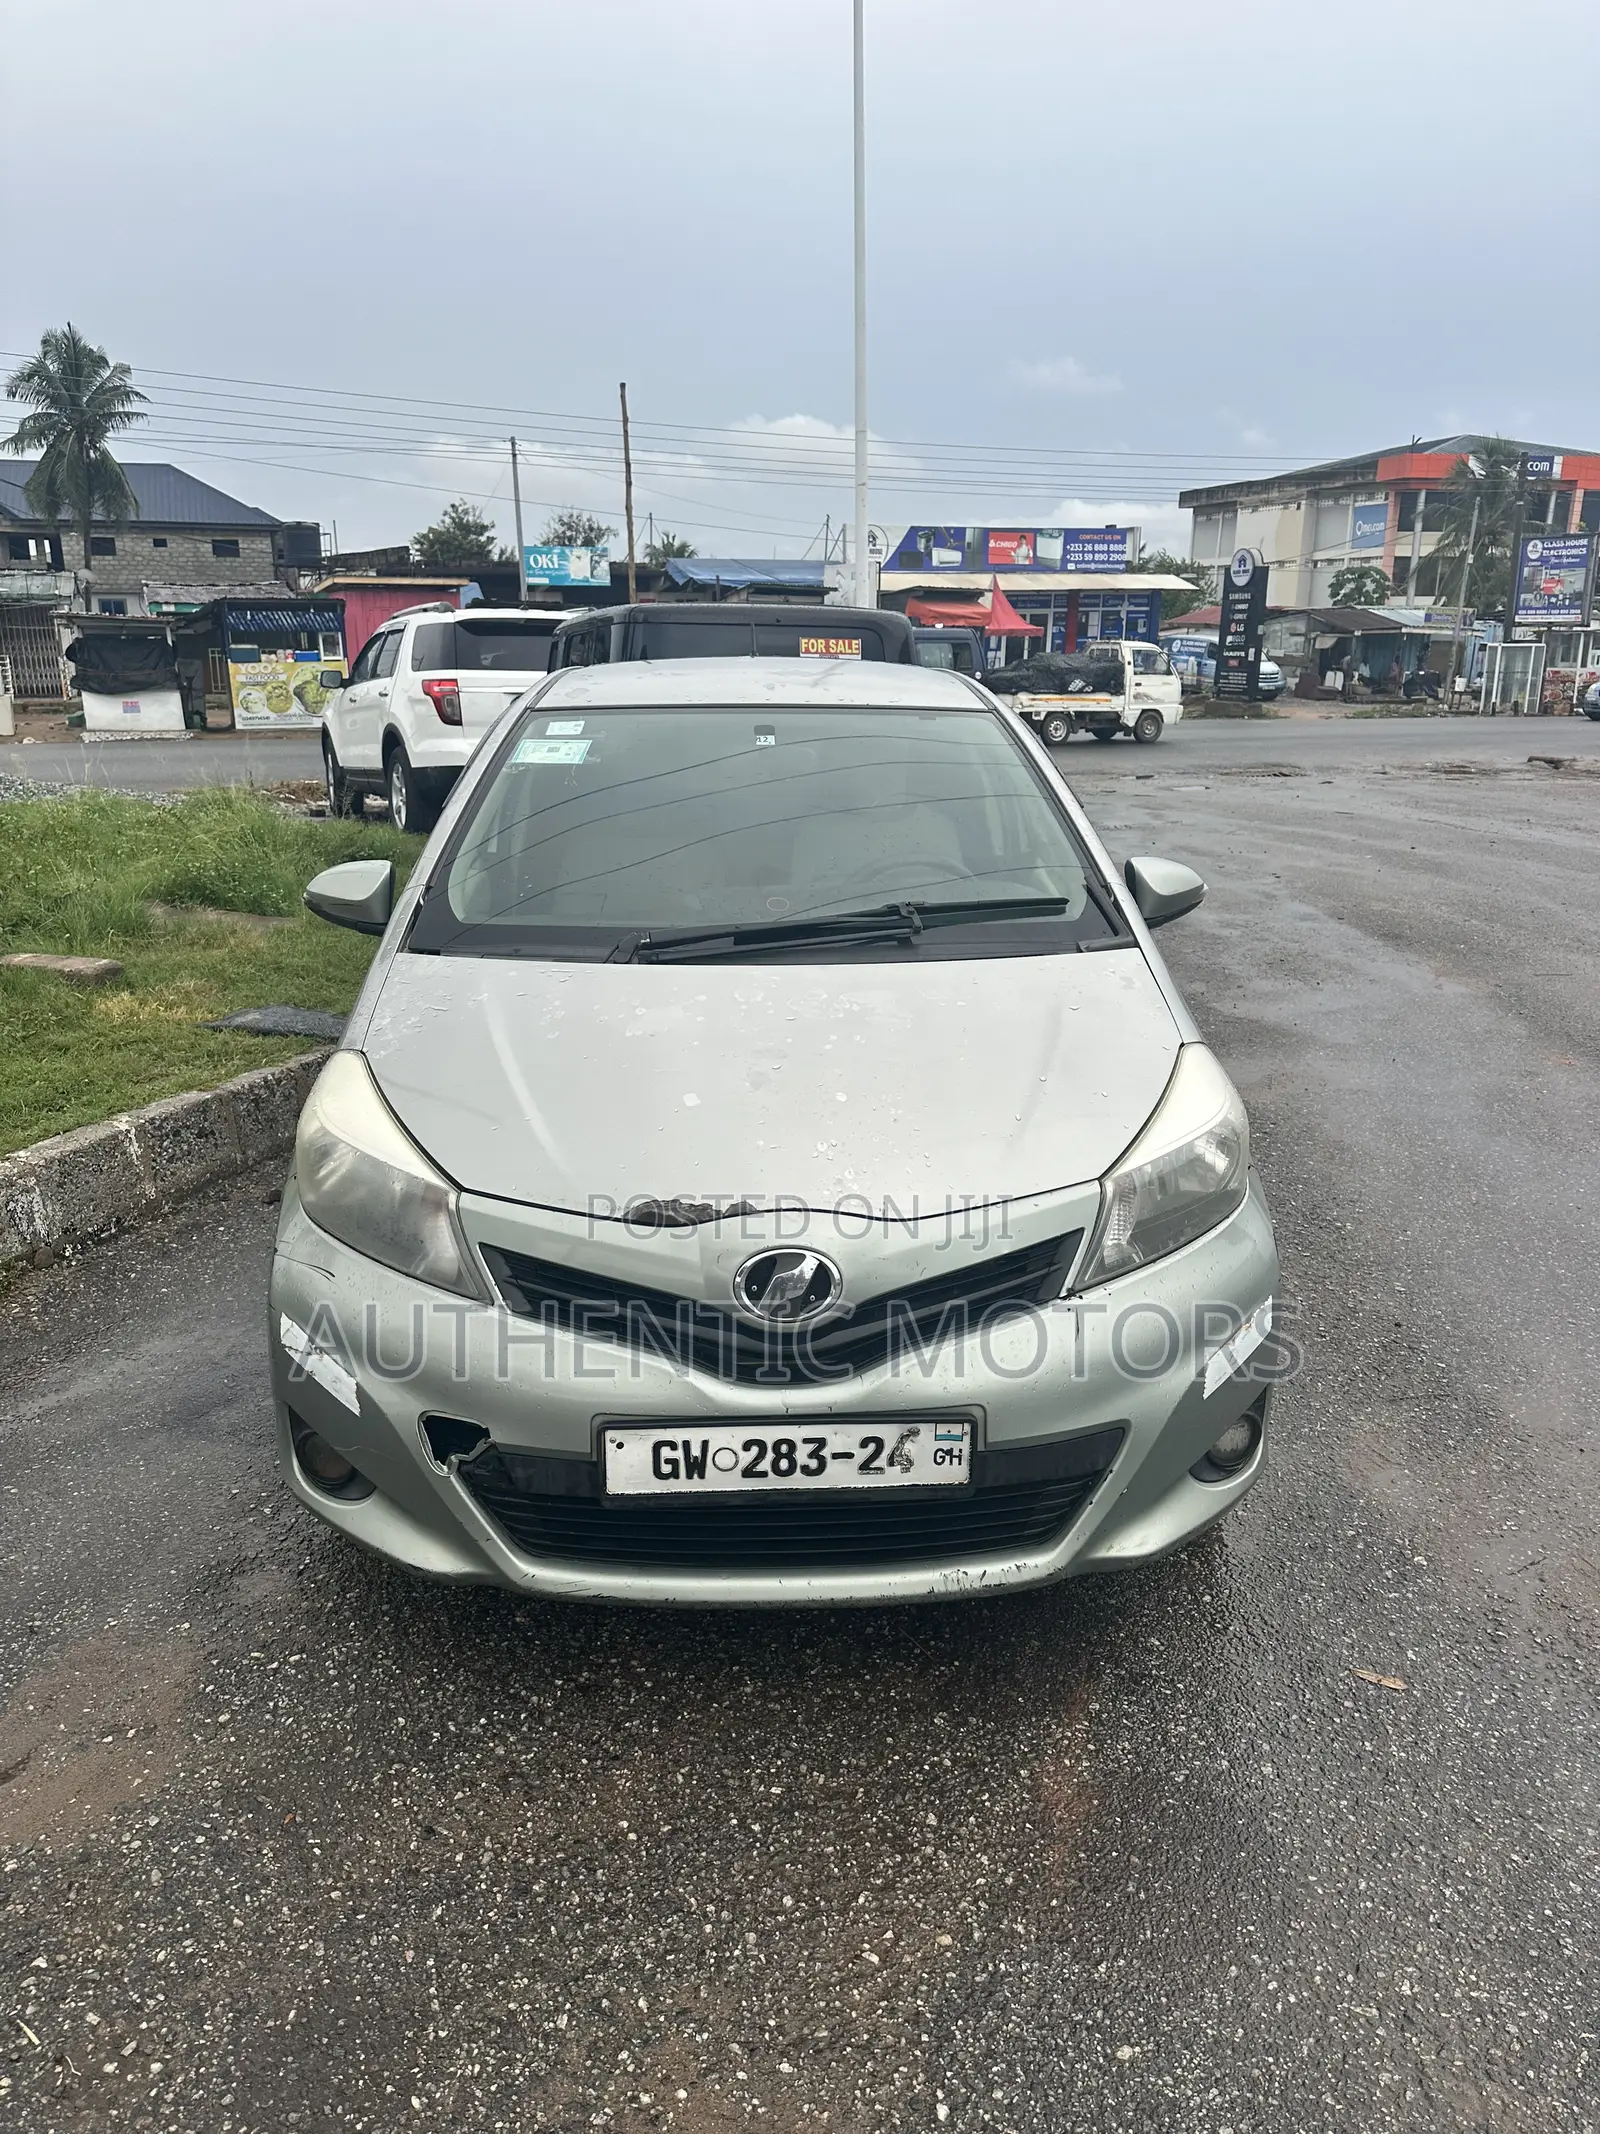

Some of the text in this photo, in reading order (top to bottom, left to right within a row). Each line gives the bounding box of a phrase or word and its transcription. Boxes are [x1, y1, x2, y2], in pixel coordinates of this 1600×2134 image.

[1543, 548, 1587, 556] ELECTRONICS
[1229, 592, 1251, 600] SAMSUNG
[801, 638, 860, 654] FOR SALE
[651, 1438, 710, 1480] GW
[933, 1447, 963, 1466] GH
